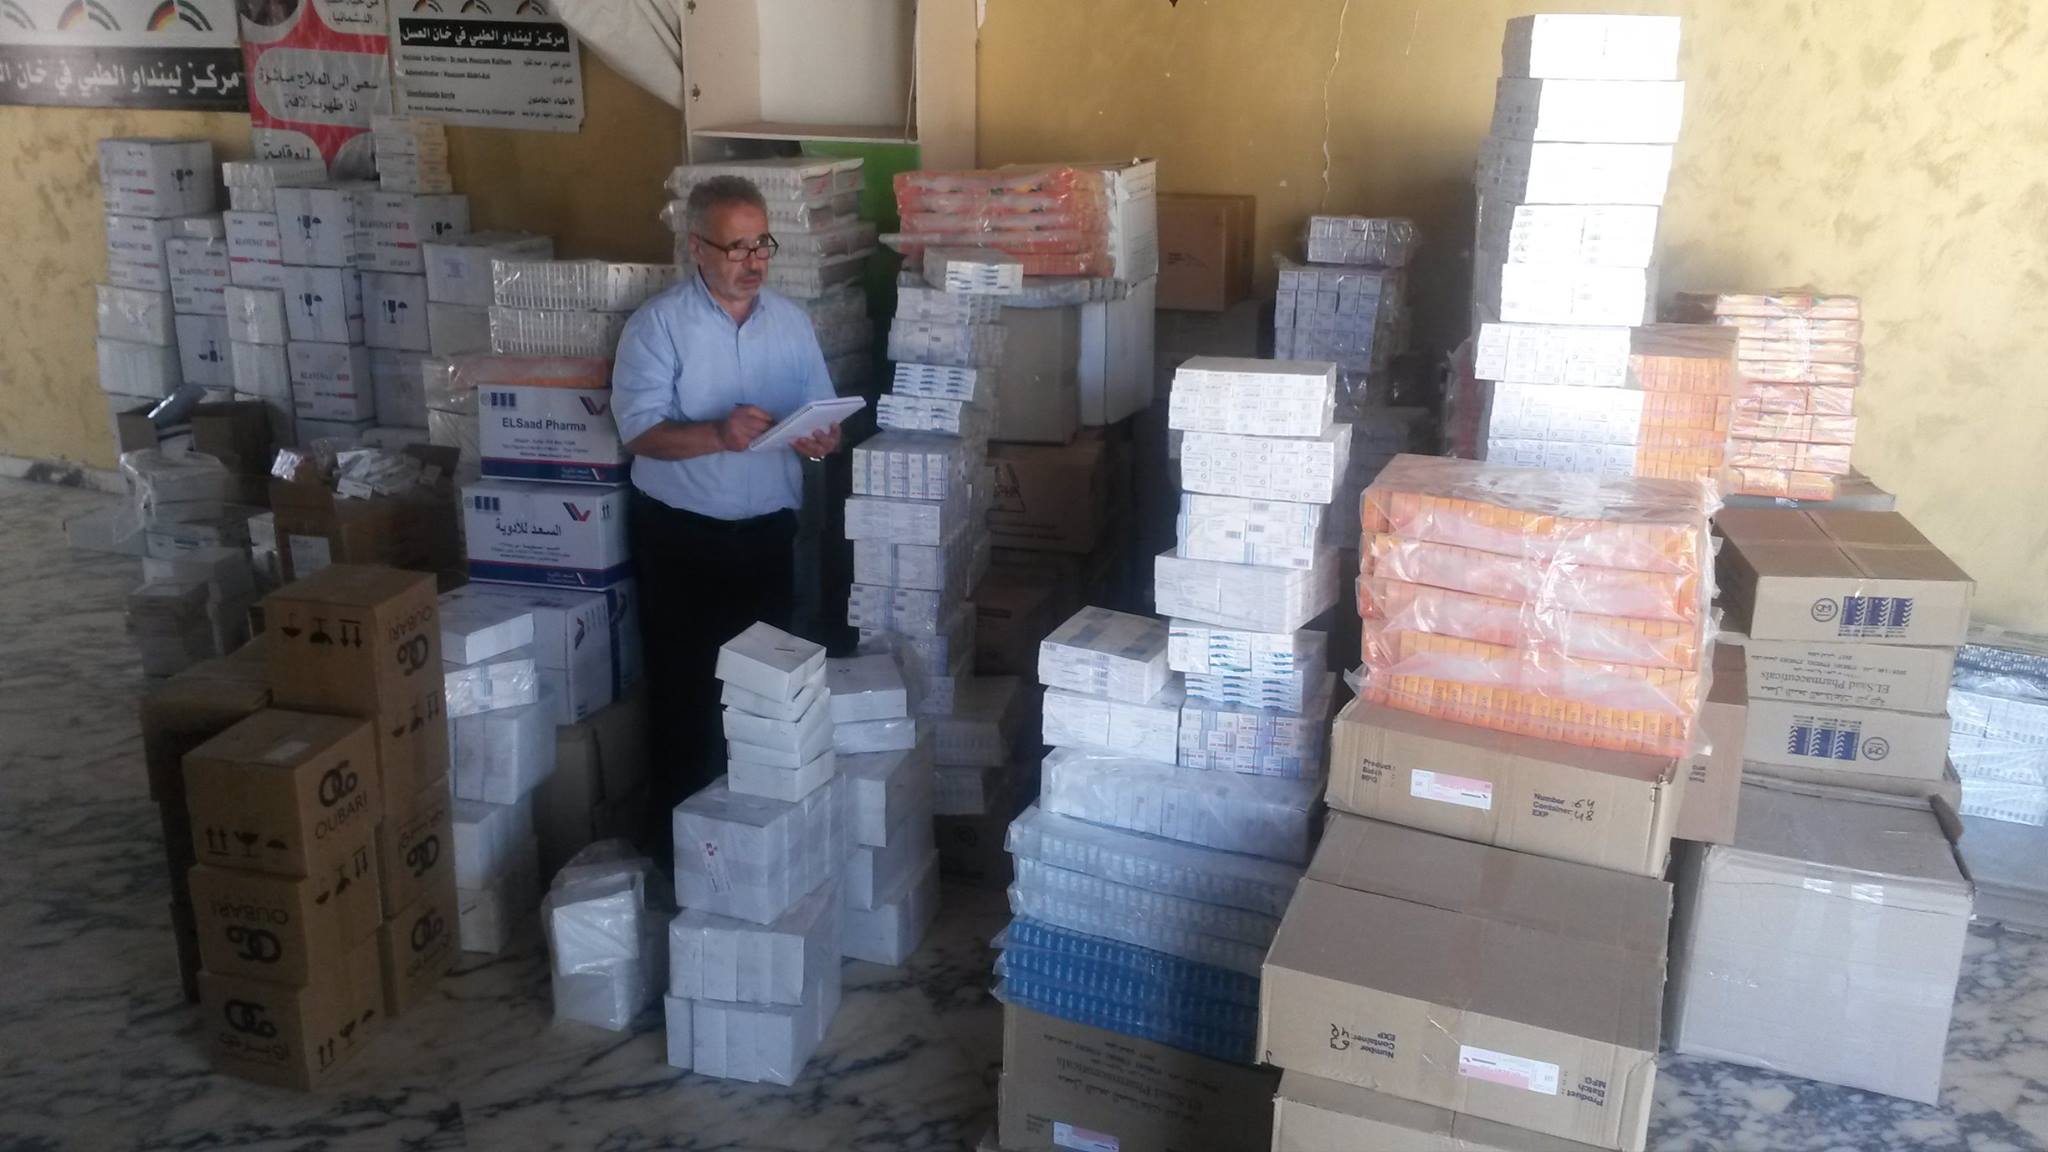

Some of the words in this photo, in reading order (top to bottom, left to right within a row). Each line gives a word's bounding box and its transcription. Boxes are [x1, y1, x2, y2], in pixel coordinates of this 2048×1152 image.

[402, 25, 431, 42] العسل
[432, 24, 452, 42] خان
[454, 25, 467, 46] في
[470, 28, 499, 47] الطبي
[503, 31, 533, 47] لينداو
[535, 29, 565, 48] مركز
[16, 58, 48, 90] خان
[54, 59, 73, 97] في
[78, 62, 126, 98] الطبي
[131, 60, 182, 95] لينداو
[188, 61, 240, 96] مركز
[502, 417, 543, 430] ELSaad
[545, 419, 587, 433] Pharma
[531, 523, 562, 537] السعد
[1362, 758, 1392, 770] Product
[314, 791, 369, 841] OUBARI
[212, 903, 289, 927] OUBARI
[1360, 1045, 1395, 1059] Number
[1566, 1089, 1604, 1106] Product
